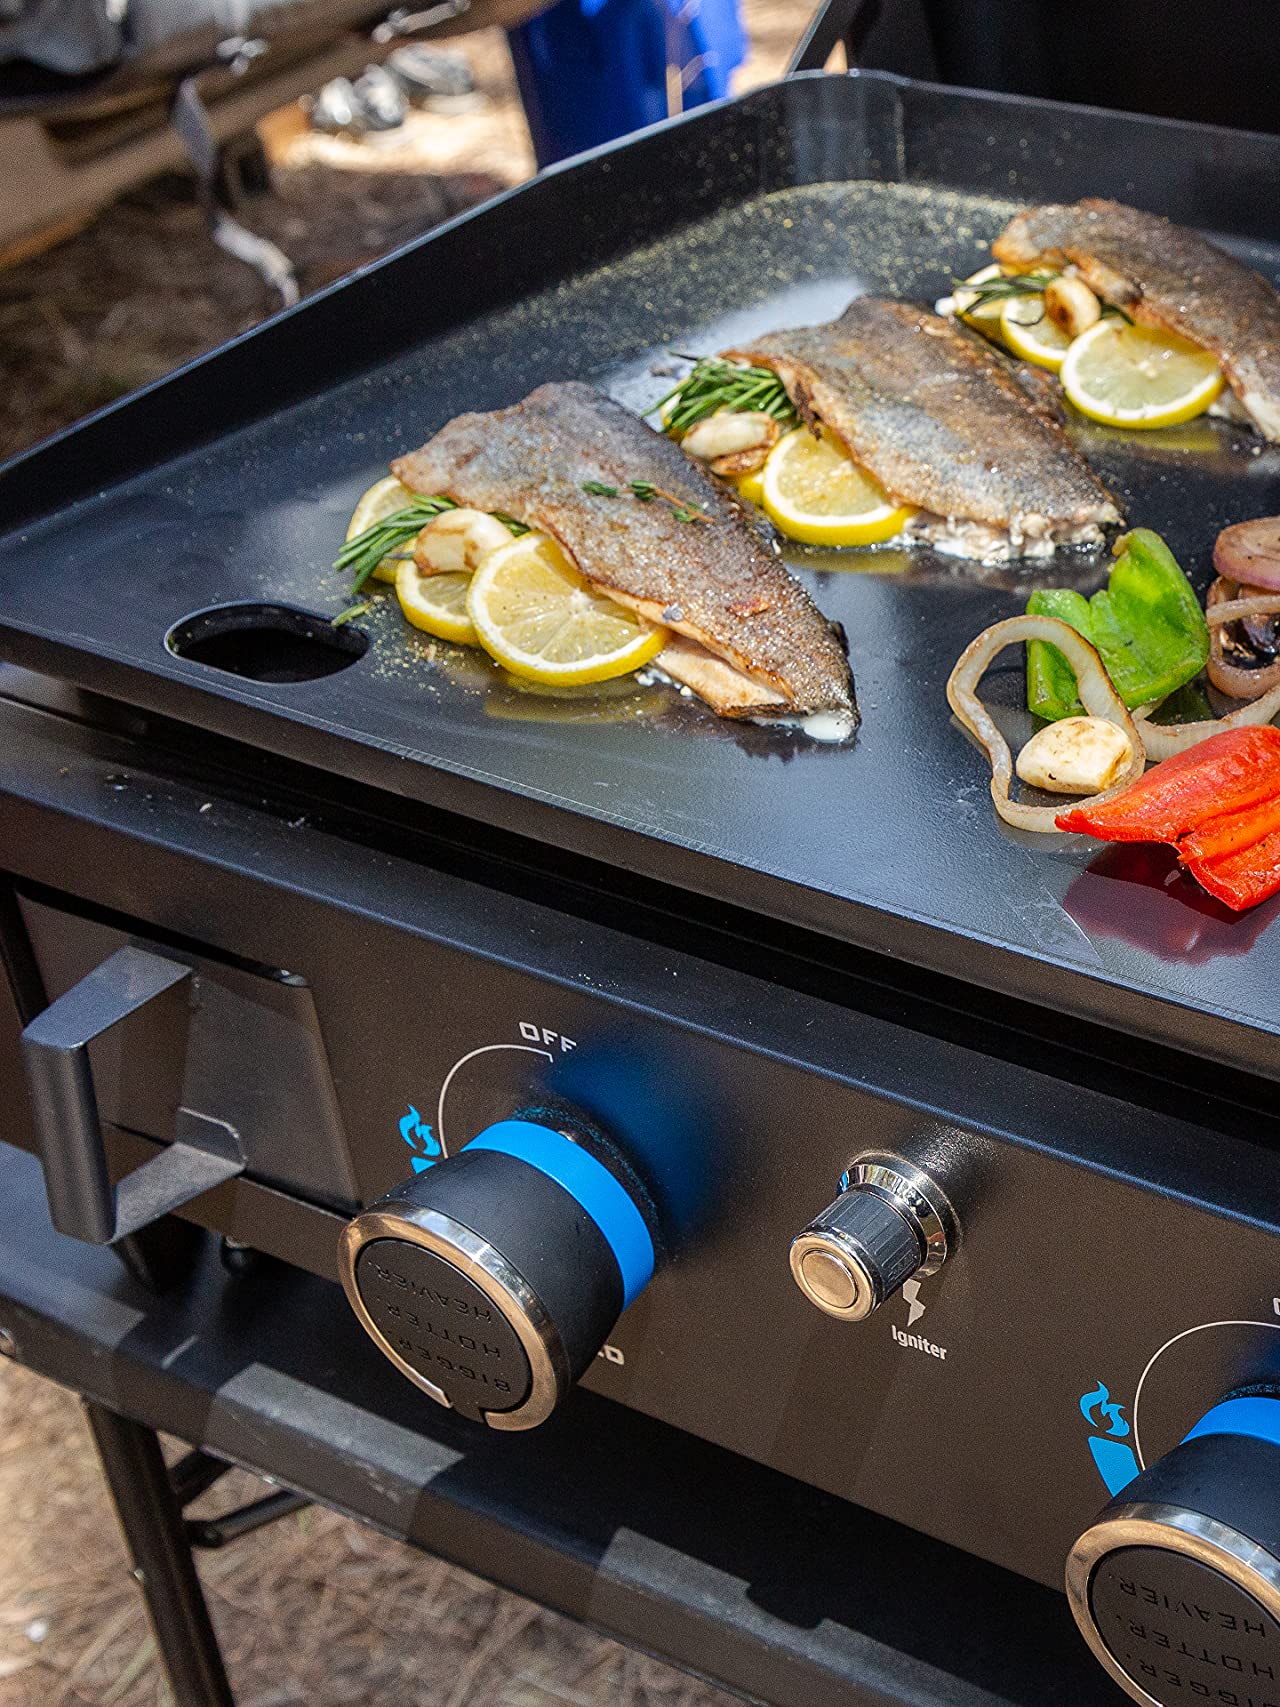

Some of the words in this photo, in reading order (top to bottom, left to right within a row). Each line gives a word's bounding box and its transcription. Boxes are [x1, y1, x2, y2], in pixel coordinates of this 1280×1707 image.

[519, 1021, 577, 1052] OFF
[891, 1324, 948, 1360] Igniter
[1126, 1654, 1280, 1707] IGGER.
